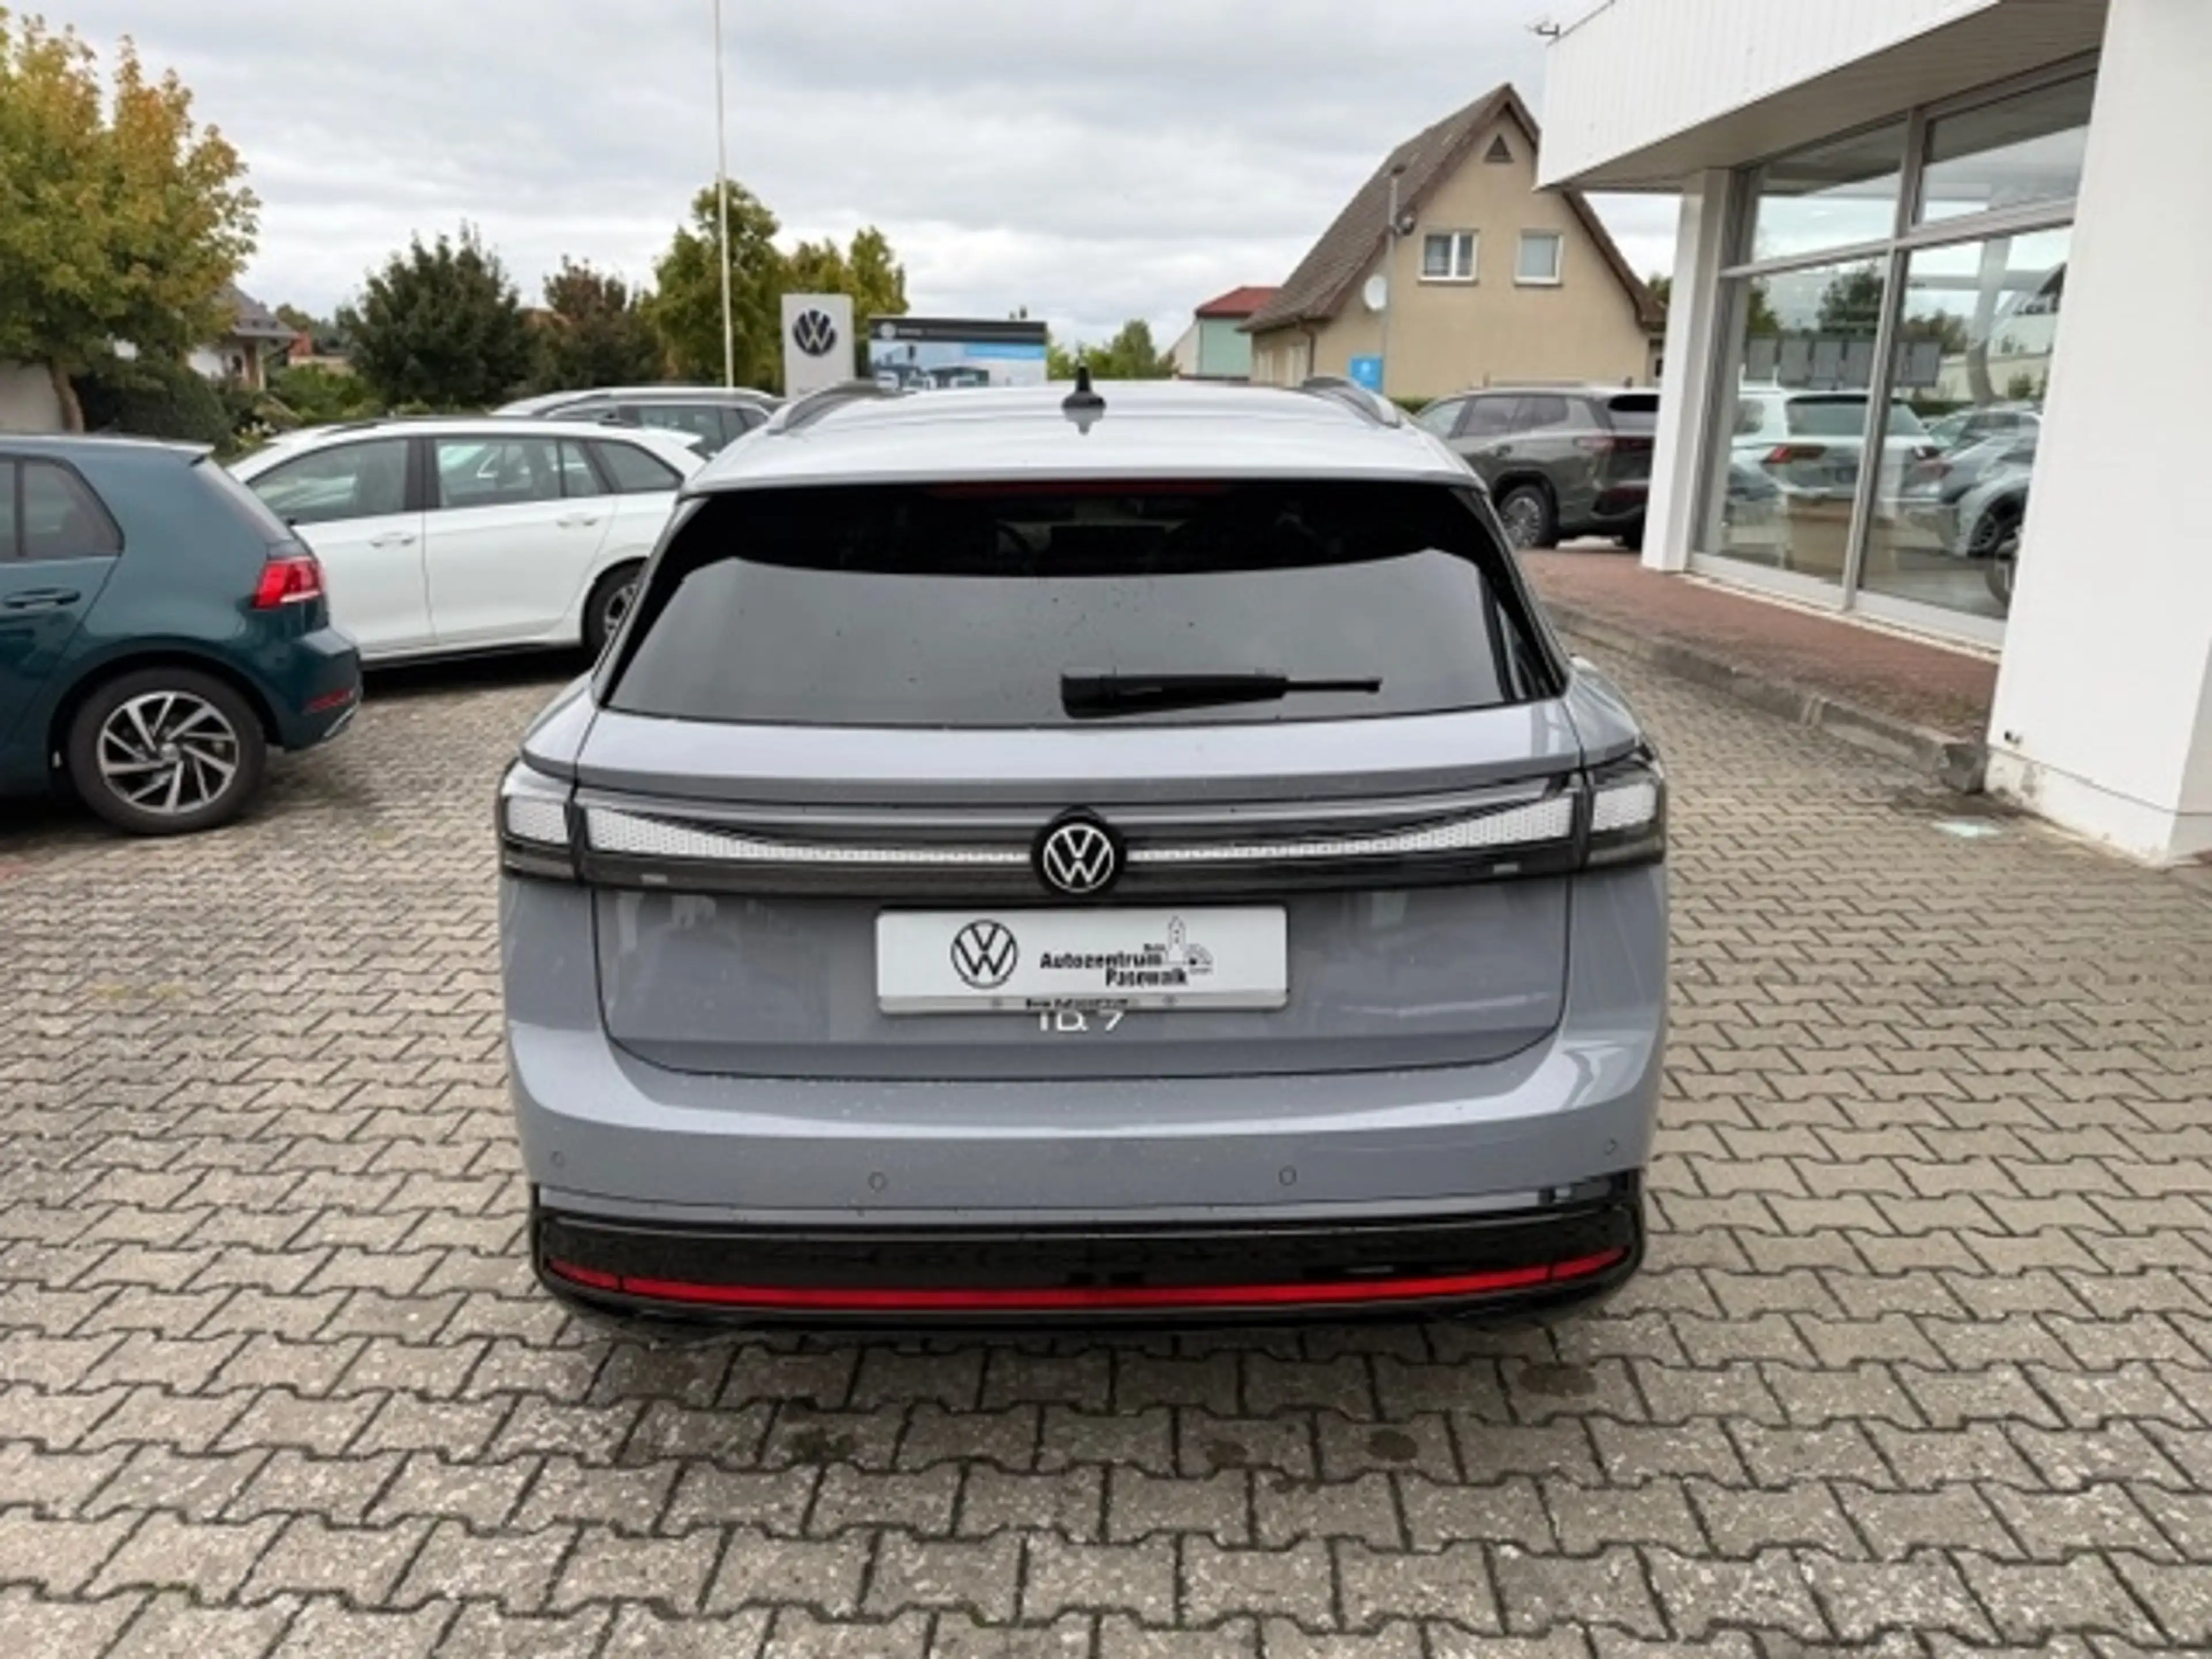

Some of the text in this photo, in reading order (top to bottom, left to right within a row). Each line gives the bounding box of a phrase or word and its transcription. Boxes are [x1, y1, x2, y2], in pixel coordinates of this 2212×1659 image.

[793, 306, 838, 357] VW
[1044, 824, 1113, 892] VW
[951, 920, 1017, 987] VW
[1040, 952, 1162, 969] Autozentrum
[1105, 968, 1187, 987] Pasewalk
